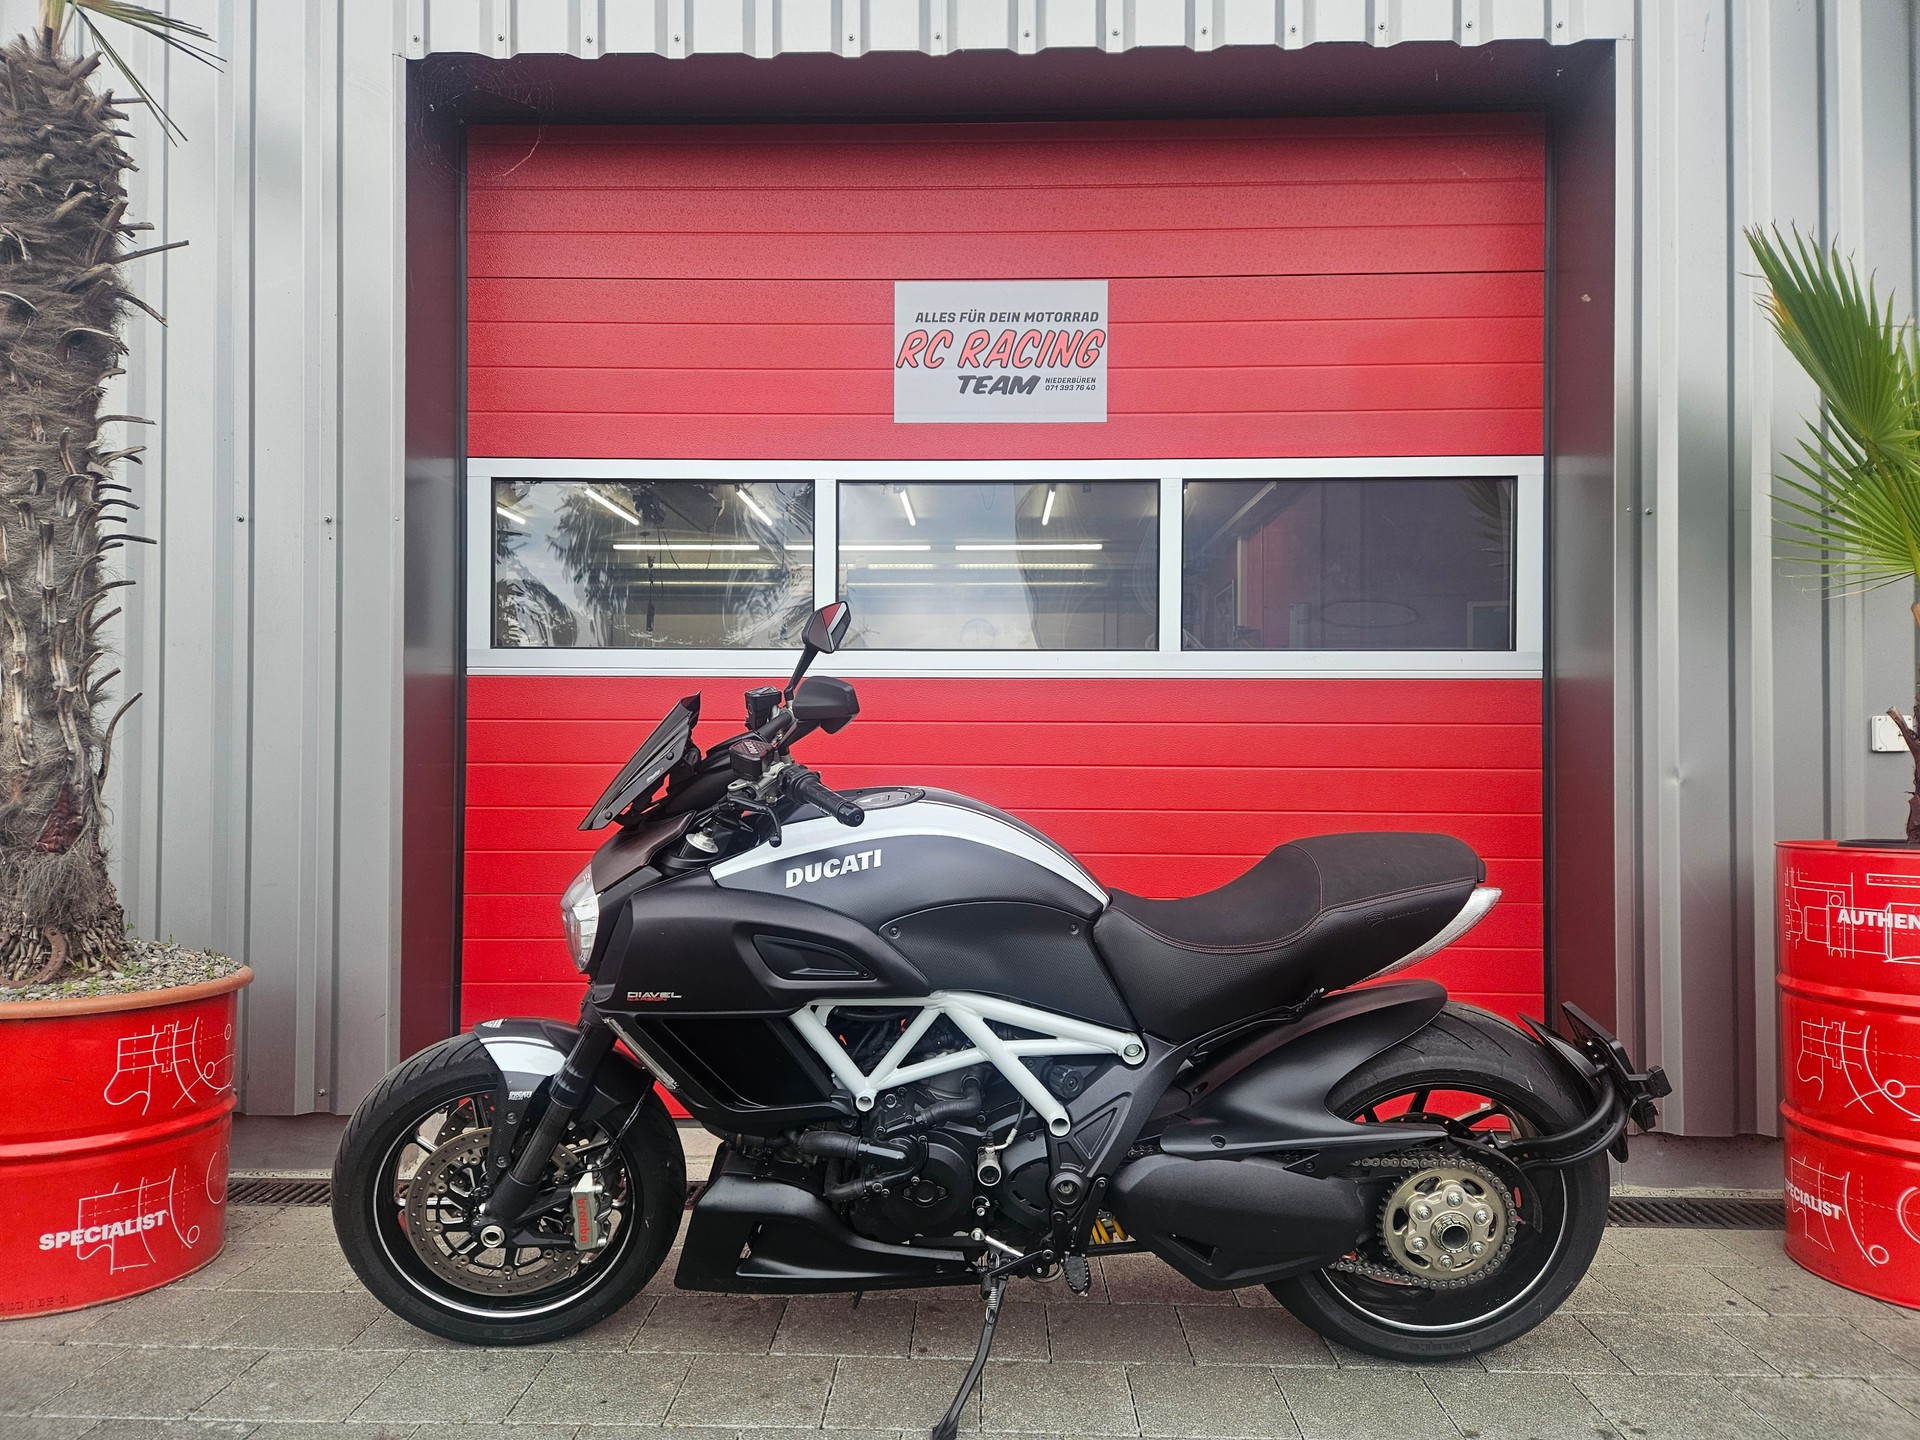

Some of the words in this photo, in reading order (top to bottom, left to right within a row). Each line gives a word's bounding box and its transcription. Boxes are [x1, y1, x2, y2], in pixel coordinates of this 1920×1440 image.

[915, 312, 956, 323] ALLES
[959, 309, 986, 323] FÜR
[989, 312, 1021, 323] DEIN
[1023, 312, 1099, 323] MOTORRAD
[896, 328, 955, 369] RC
[957, 328, 1106, 369] RACING
[958, 375, 1041, 395] TEAM
[1045, 375, 1096, 384] NIEDERBÜREN
[785, 849, 882, 889] DUCATI
[627, 991, 682, 999] DIAVEL
[38, 1209, 168, 1251] SPECIALIST
[577, 1197, 591, 1243] brembo
